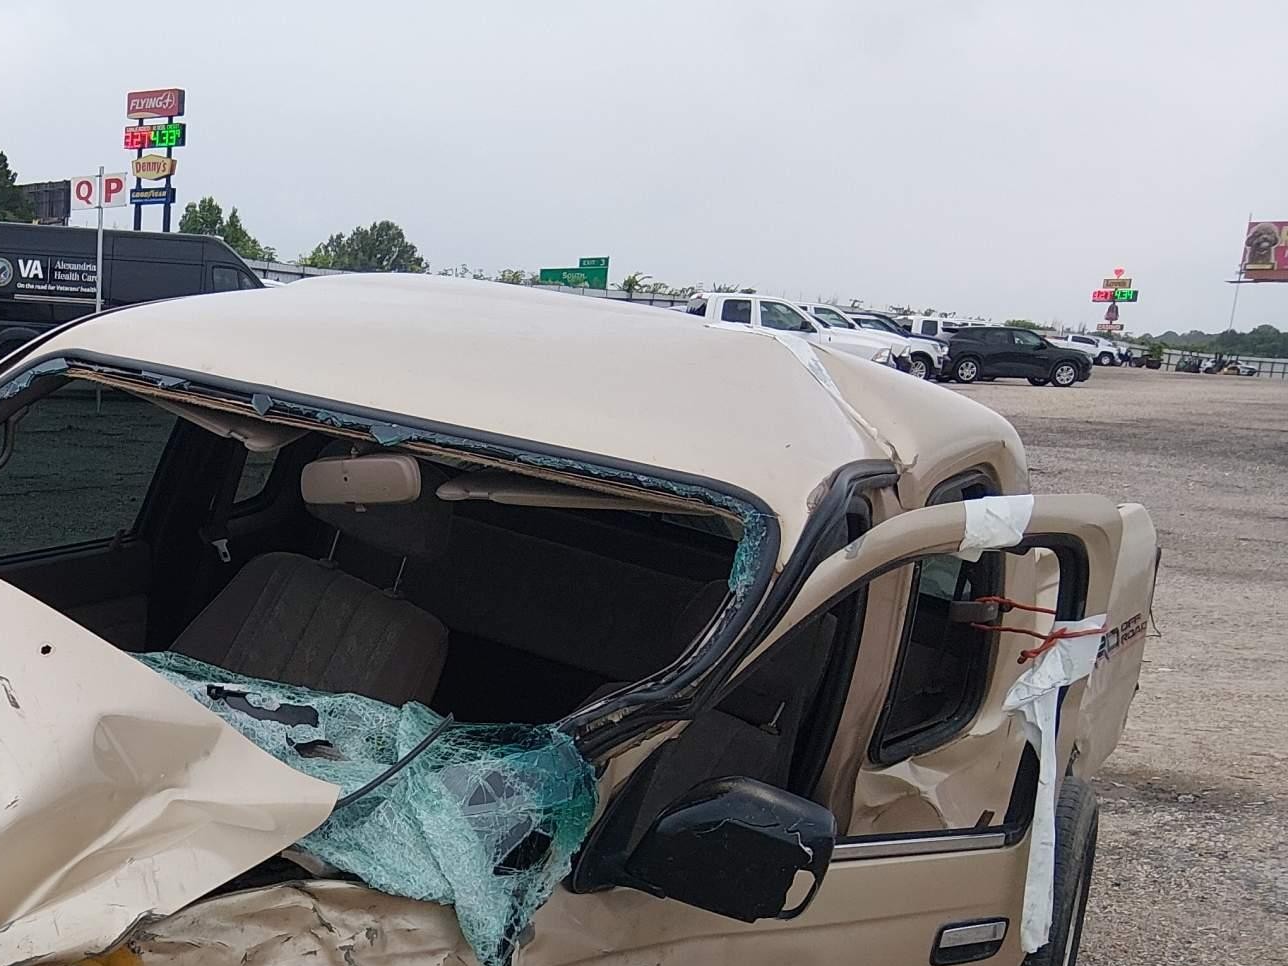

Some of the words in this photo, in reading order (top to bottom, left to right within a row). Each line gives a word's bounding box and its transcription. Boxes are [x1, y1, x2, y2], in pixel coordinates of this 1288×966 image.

[130, 97, 162, 110] FLYING
[135, 160, 167, 174] Denny's
[75, 180, 92, 204] Q
[105, 178, 123, 203] P
[18, 259, 43, 279] VA
[54, 260, 97, 272] Alexandria
[54, 271, 80, 281] Health
[1121, 613, 1142, 632] OFF
[1121, 621, 1148, 645] ROAD
